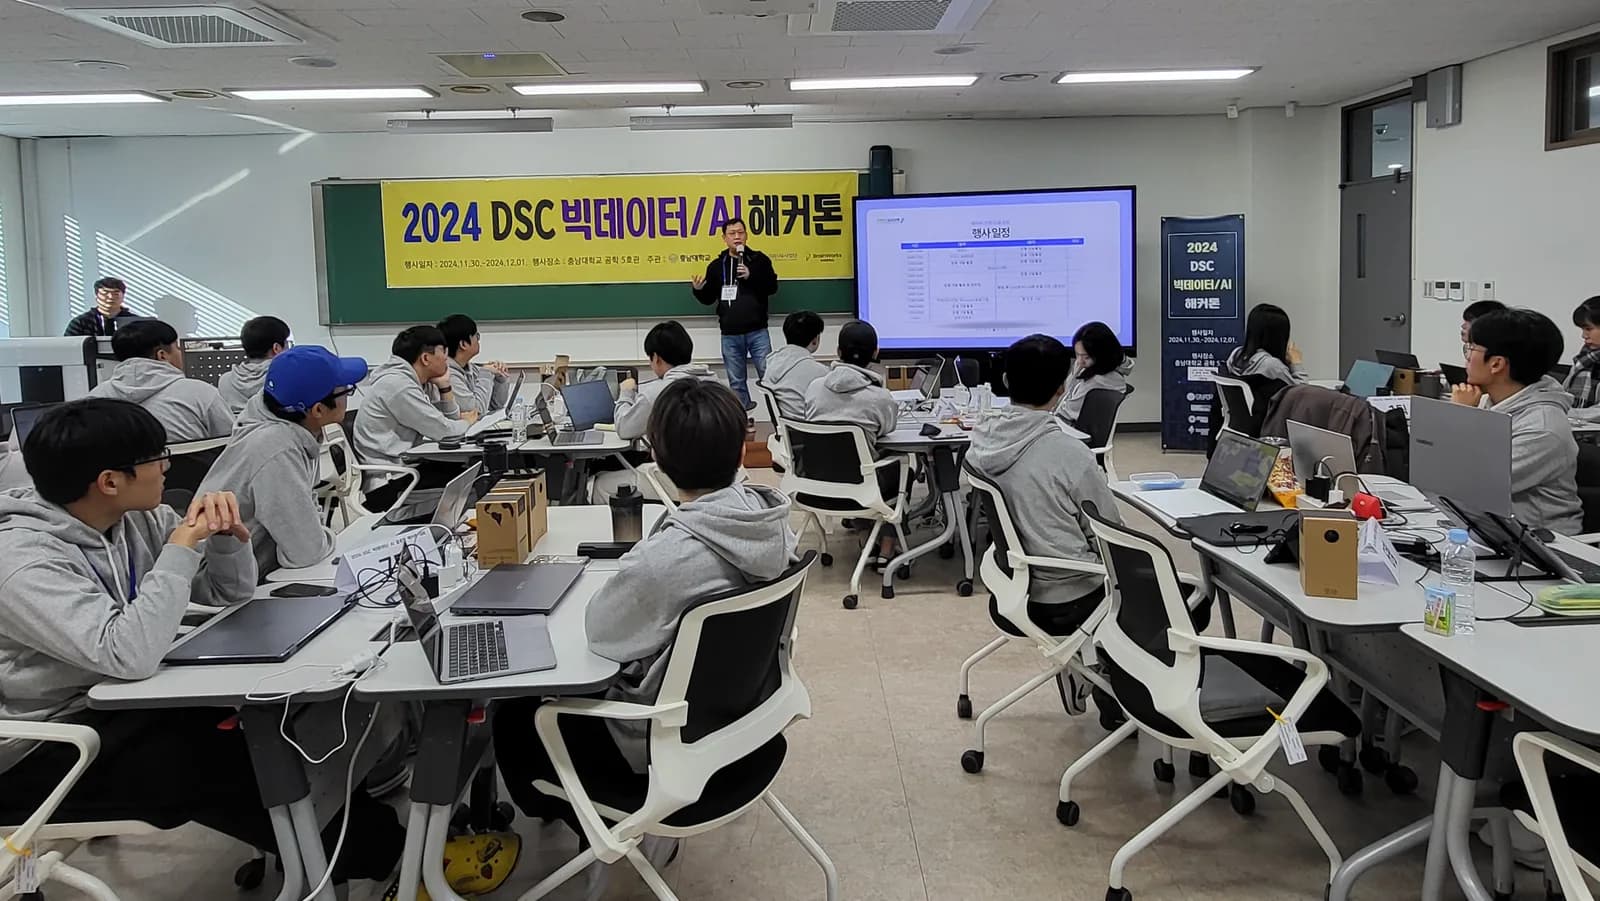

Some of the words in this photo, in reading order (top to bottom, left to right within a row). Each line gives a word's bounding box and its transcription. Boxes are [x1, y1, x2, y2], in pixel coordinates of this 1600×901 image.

[402, 202, 481, 243] 2024
[492, 200, 555, 240] DSC
[748, 194, 842, 236] 해커톤
[972, 227, 1010, 239] 행사일정
[1187, 242, 1218, 253] 2024
[568, 256, 602, 266] 충남대학교
[647, 256, 661, 264] 주관
[1190, 260, 1215, 272] DSC
[1173, 278, 1232, 291] 빅데이터/AI
[1185, 297, 1221, 310] 해커톤
